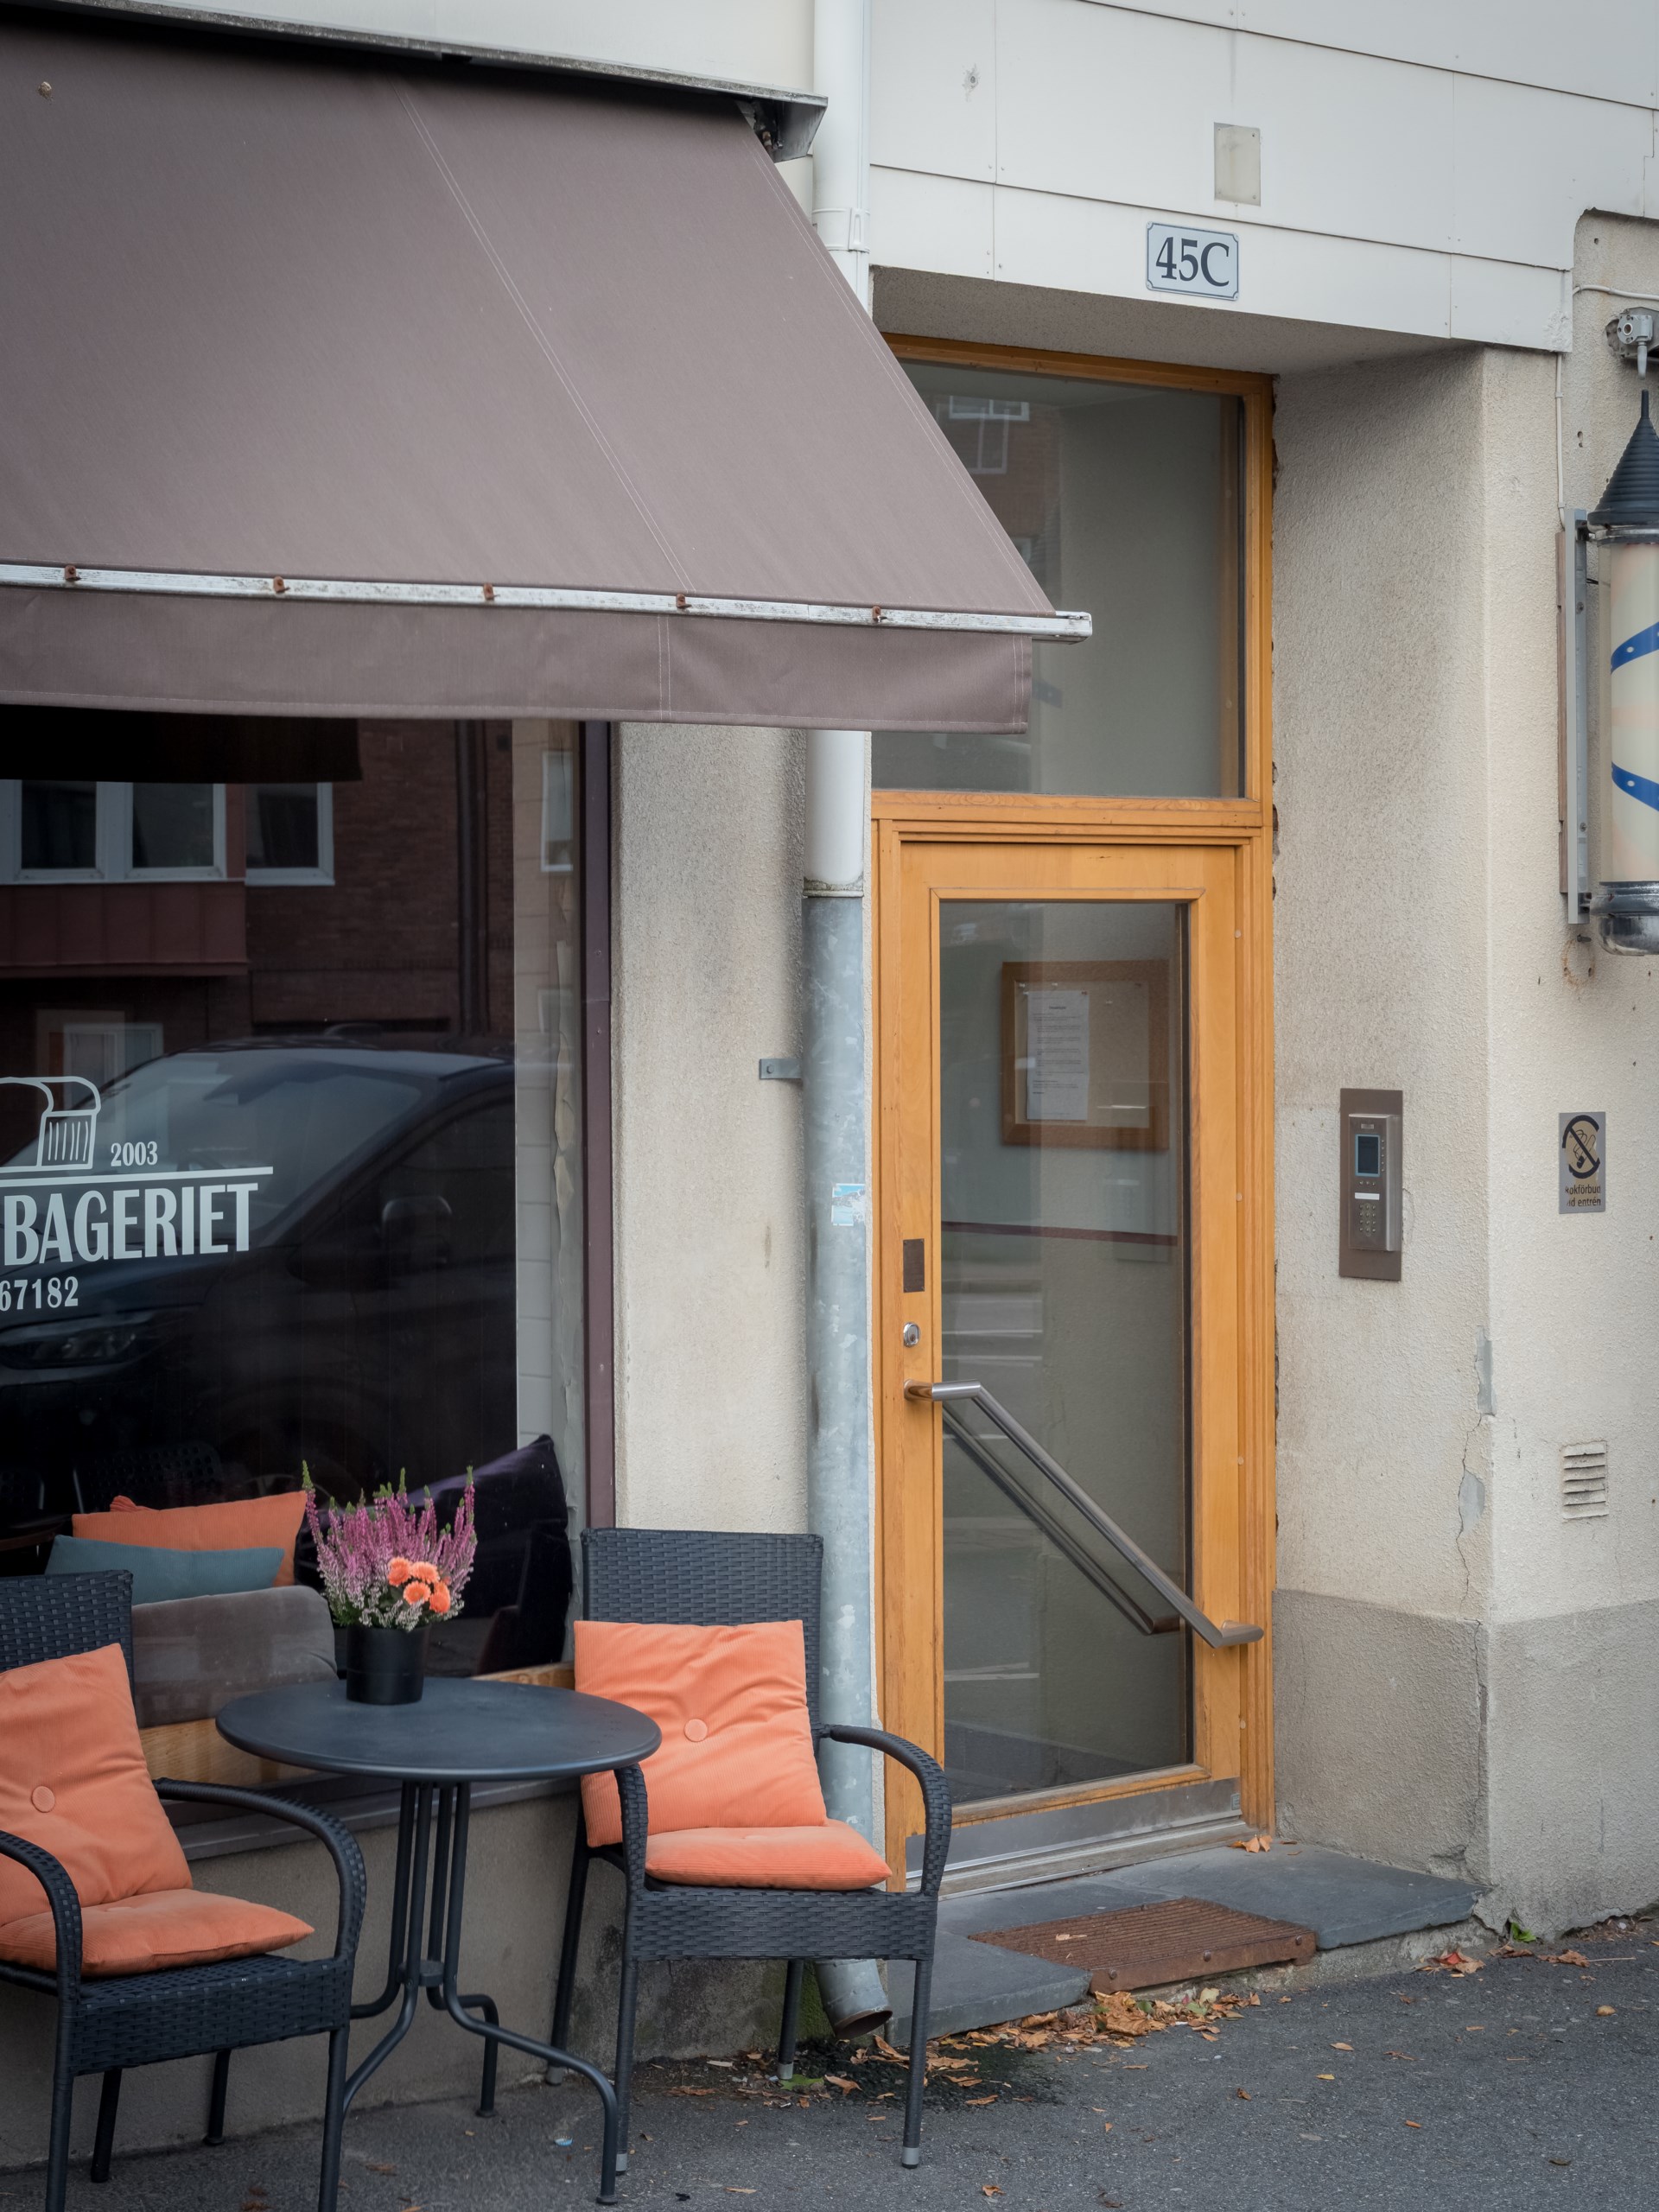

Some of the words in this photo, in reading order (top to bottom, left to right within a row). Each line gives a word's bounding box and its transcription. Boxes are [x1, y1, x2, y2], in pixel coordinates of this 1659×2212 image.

[1155, 236, 1230, 288] 45C
[110, 1141, 159, 1167] 2003
[3, 1182, 259, 1267] BAGERIET
[0, 1275, 79, 1312] 67182
